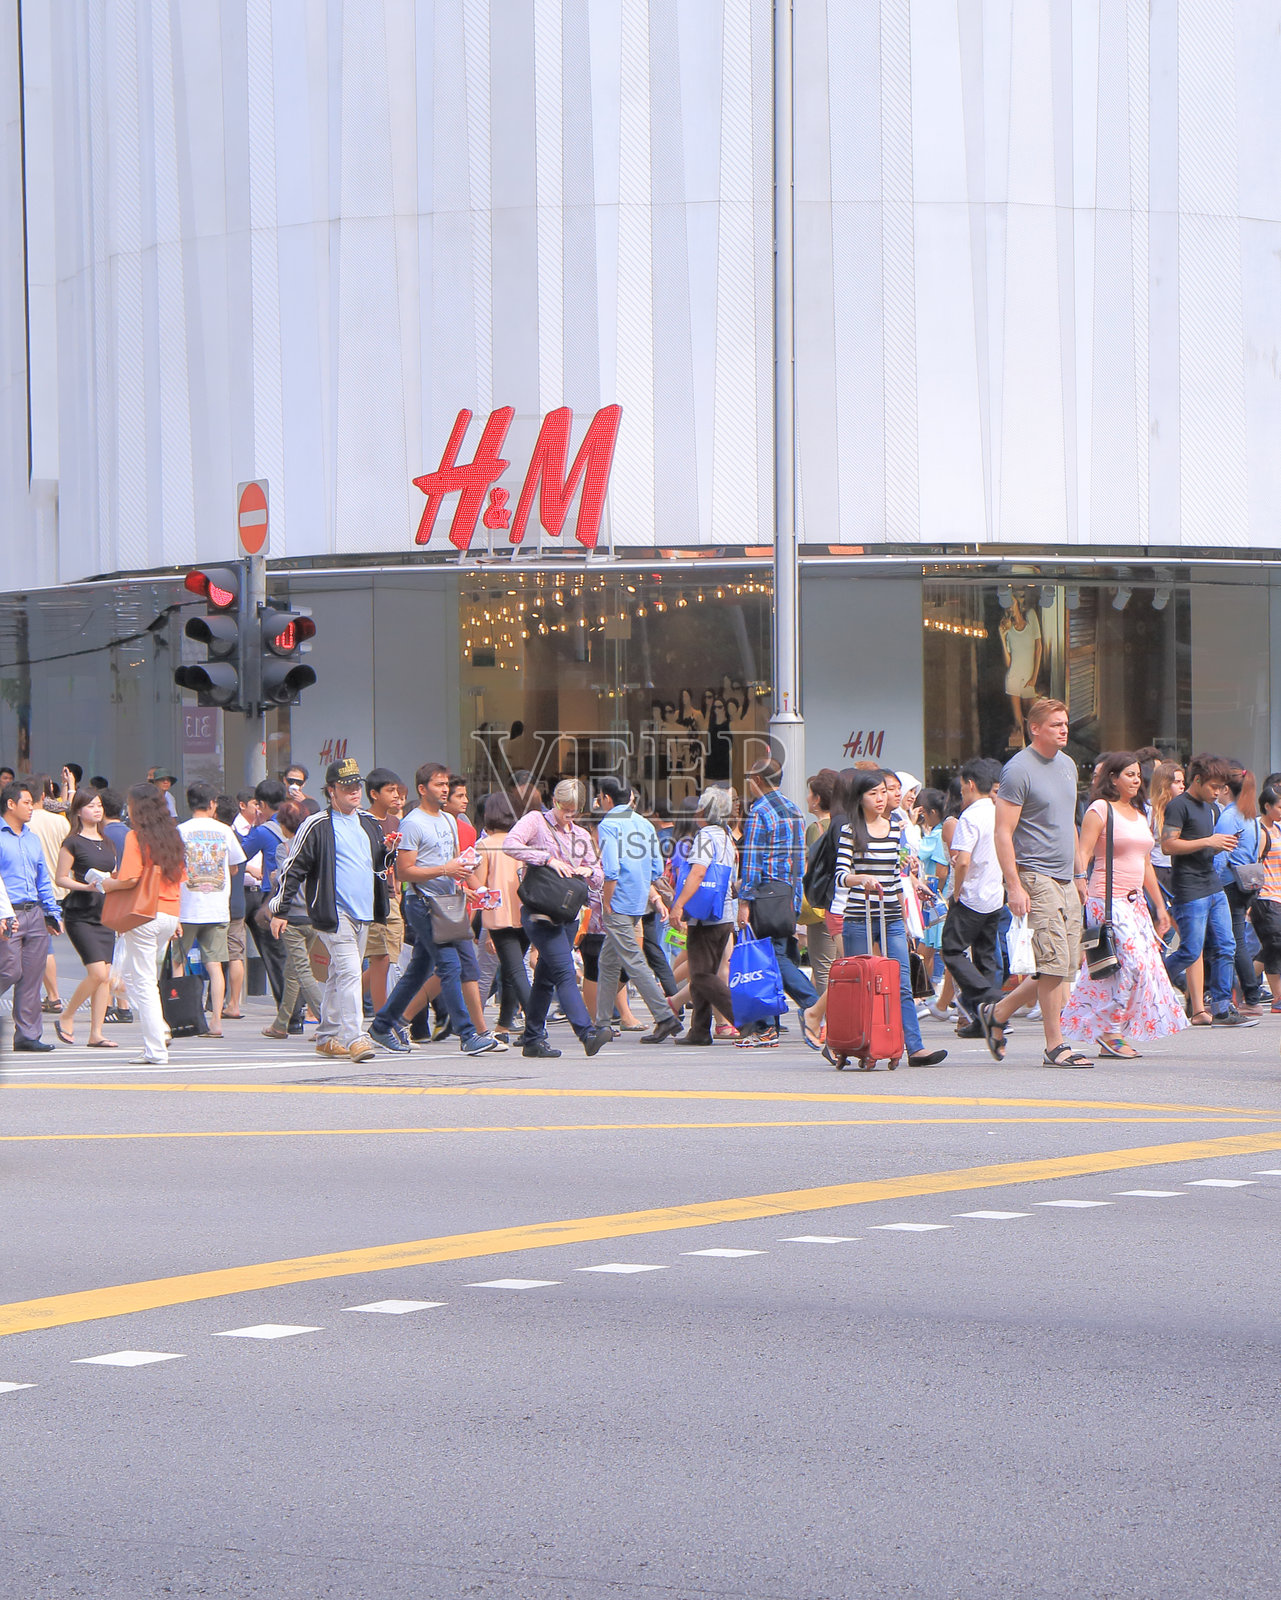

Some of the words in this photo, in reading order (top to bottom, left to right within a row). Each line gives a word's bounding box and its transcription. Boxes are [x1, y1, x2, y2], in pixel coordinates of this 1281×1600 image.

[412, 403, 623, 551] H&M
[842, 730, 884, 759] H&M
[682, 879, 717, 889] SUNG
